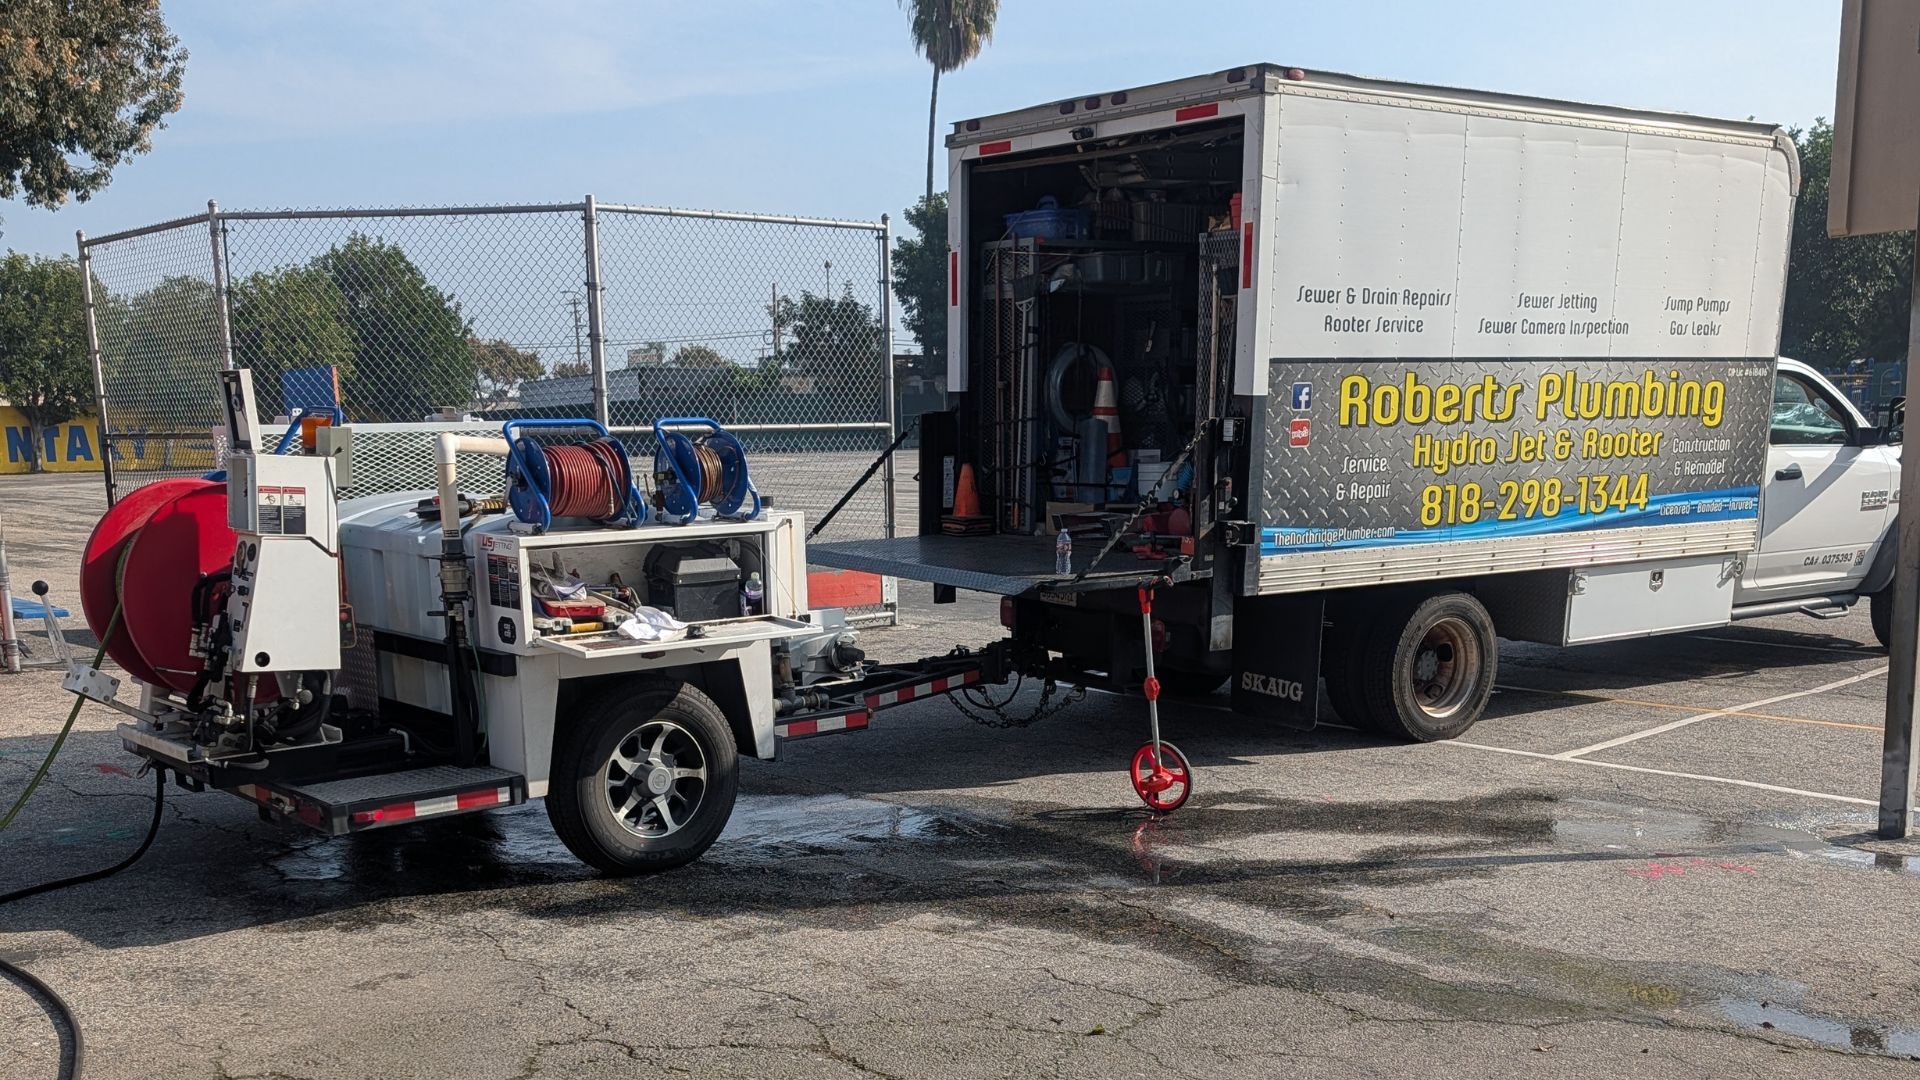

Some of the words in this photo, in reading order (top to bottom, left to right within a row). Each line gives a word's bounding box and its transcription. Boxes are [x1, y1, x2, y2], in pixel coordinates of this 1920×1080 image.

[1297, 286, 1341, 304] Sewer
[1346, 287, 1356, 304] &
[1362, 287, 1397, 305] Drain
[1403, 289, 1452, 310] Repairs
[1517, 292, 1554, 309] Sewer
[1558, 293, 1597, 313] Jetting
[1664, 296, 1693, 314] Sump
[1697, 297, 1731, 315] Pumps
[1324, 315, 1371, 332] Rooter
[1375, 315, 1424, 333] Service
[1478, 318, 1517, 334] Sewer
[1521, 319, 1565, 335] Camera
[1569, 318, 1629, 338] Inspection
[1669, 320, 1687, 336] Gas
[1692, 321, 1722, 336] Leaks
[1339, 372, 1521, 427] Roberts
[1536, 371, 1725, 427] Plumbing
[1413, 432, 1496, 476] Hydro
[1506, 431, 1546, 463] Jet
[1554, 430, 1574, 459] &
[1582, 428, 1664, 459] Rooter
[1672, 436, 1731, 454] Construction
[1341, 455, 1388, 474] Service
[1674, 461, 1681, 476] &
[1684, 458, 1726, 476] Remodel
[1336, 483, 1346, 501] &
[1350, 481, 1391, 504] Repair
[1419, 473, 1650, 528] 818-298-1344
[1660, 501, 1691, 516] Licensed
[1697, 501, 1722, 513] Bonded
[1729, 499, 1753, 511] Insured
[1274, 526, 1395, 546] TheNorthridgePlumber.com
[1242, 671, 1304, 702] SKAUG
